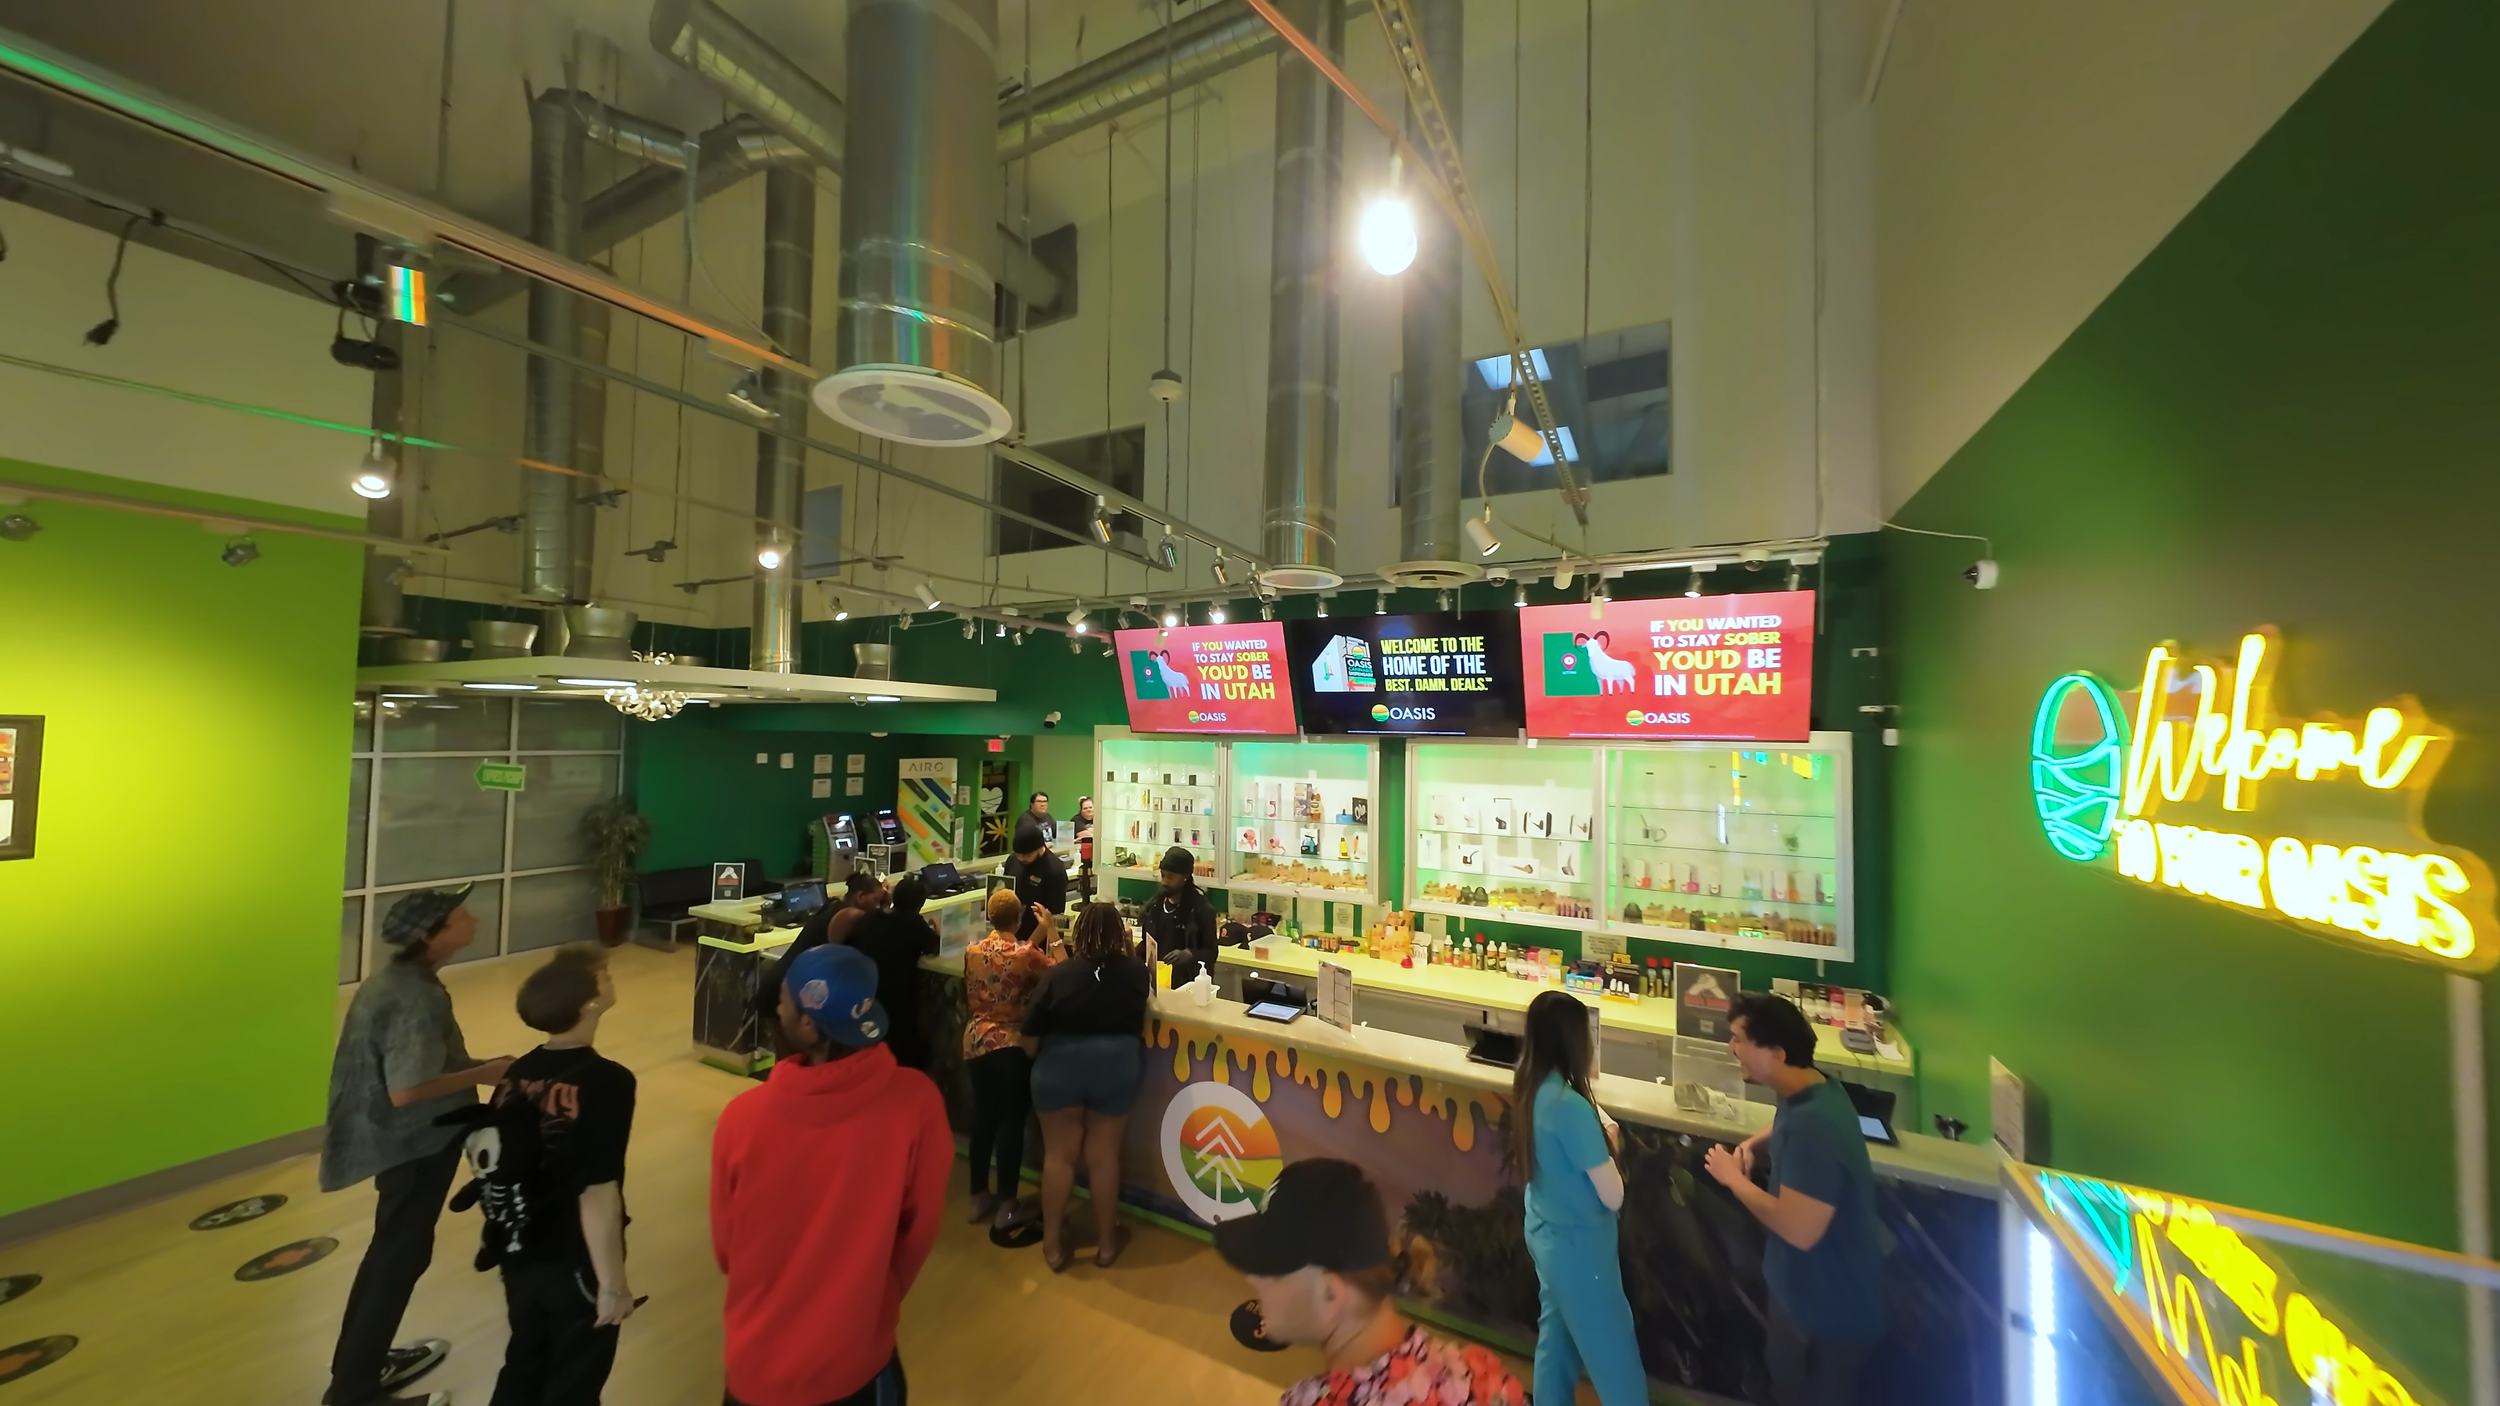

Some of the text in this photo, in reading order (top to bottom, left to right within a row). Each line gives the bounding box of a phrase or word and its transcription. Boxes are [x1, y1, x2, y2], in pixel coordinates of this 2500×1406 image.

[1650, 615, 1782, 632] IF YOU WANTED
[1192, 639, 1268, 652] IF YOU WANTED
[1380, 636, 1484, 654] WELCOME TO THE
[1652, 632, 1781, 648] TO STAY SOBER
[1194, 652, 1270, 663] TO STAY SOBER
[1347, 660, 1372, 668] OASIS
[1382, 654, 1486, 676] HOME OF THE
[1653, 648, 1781, 671] YOU'D BE
[1197, 664, 1272, 681] YOU'D BE
[1200, 682, 1276, 700] IN UTAH
[1385, 678, 1414, 692] BEST.
[1415, 678, 1449, 692] DAMN.
[1654, 672, 1782, 696] IN UTAH
[1199, 712, 1227, 722] OASIS
[1389, 706, 1436, 720] OASIS
[1644, 712, 1690, 724] OASIS
[2125, 633, 2446, 817] Welcome
